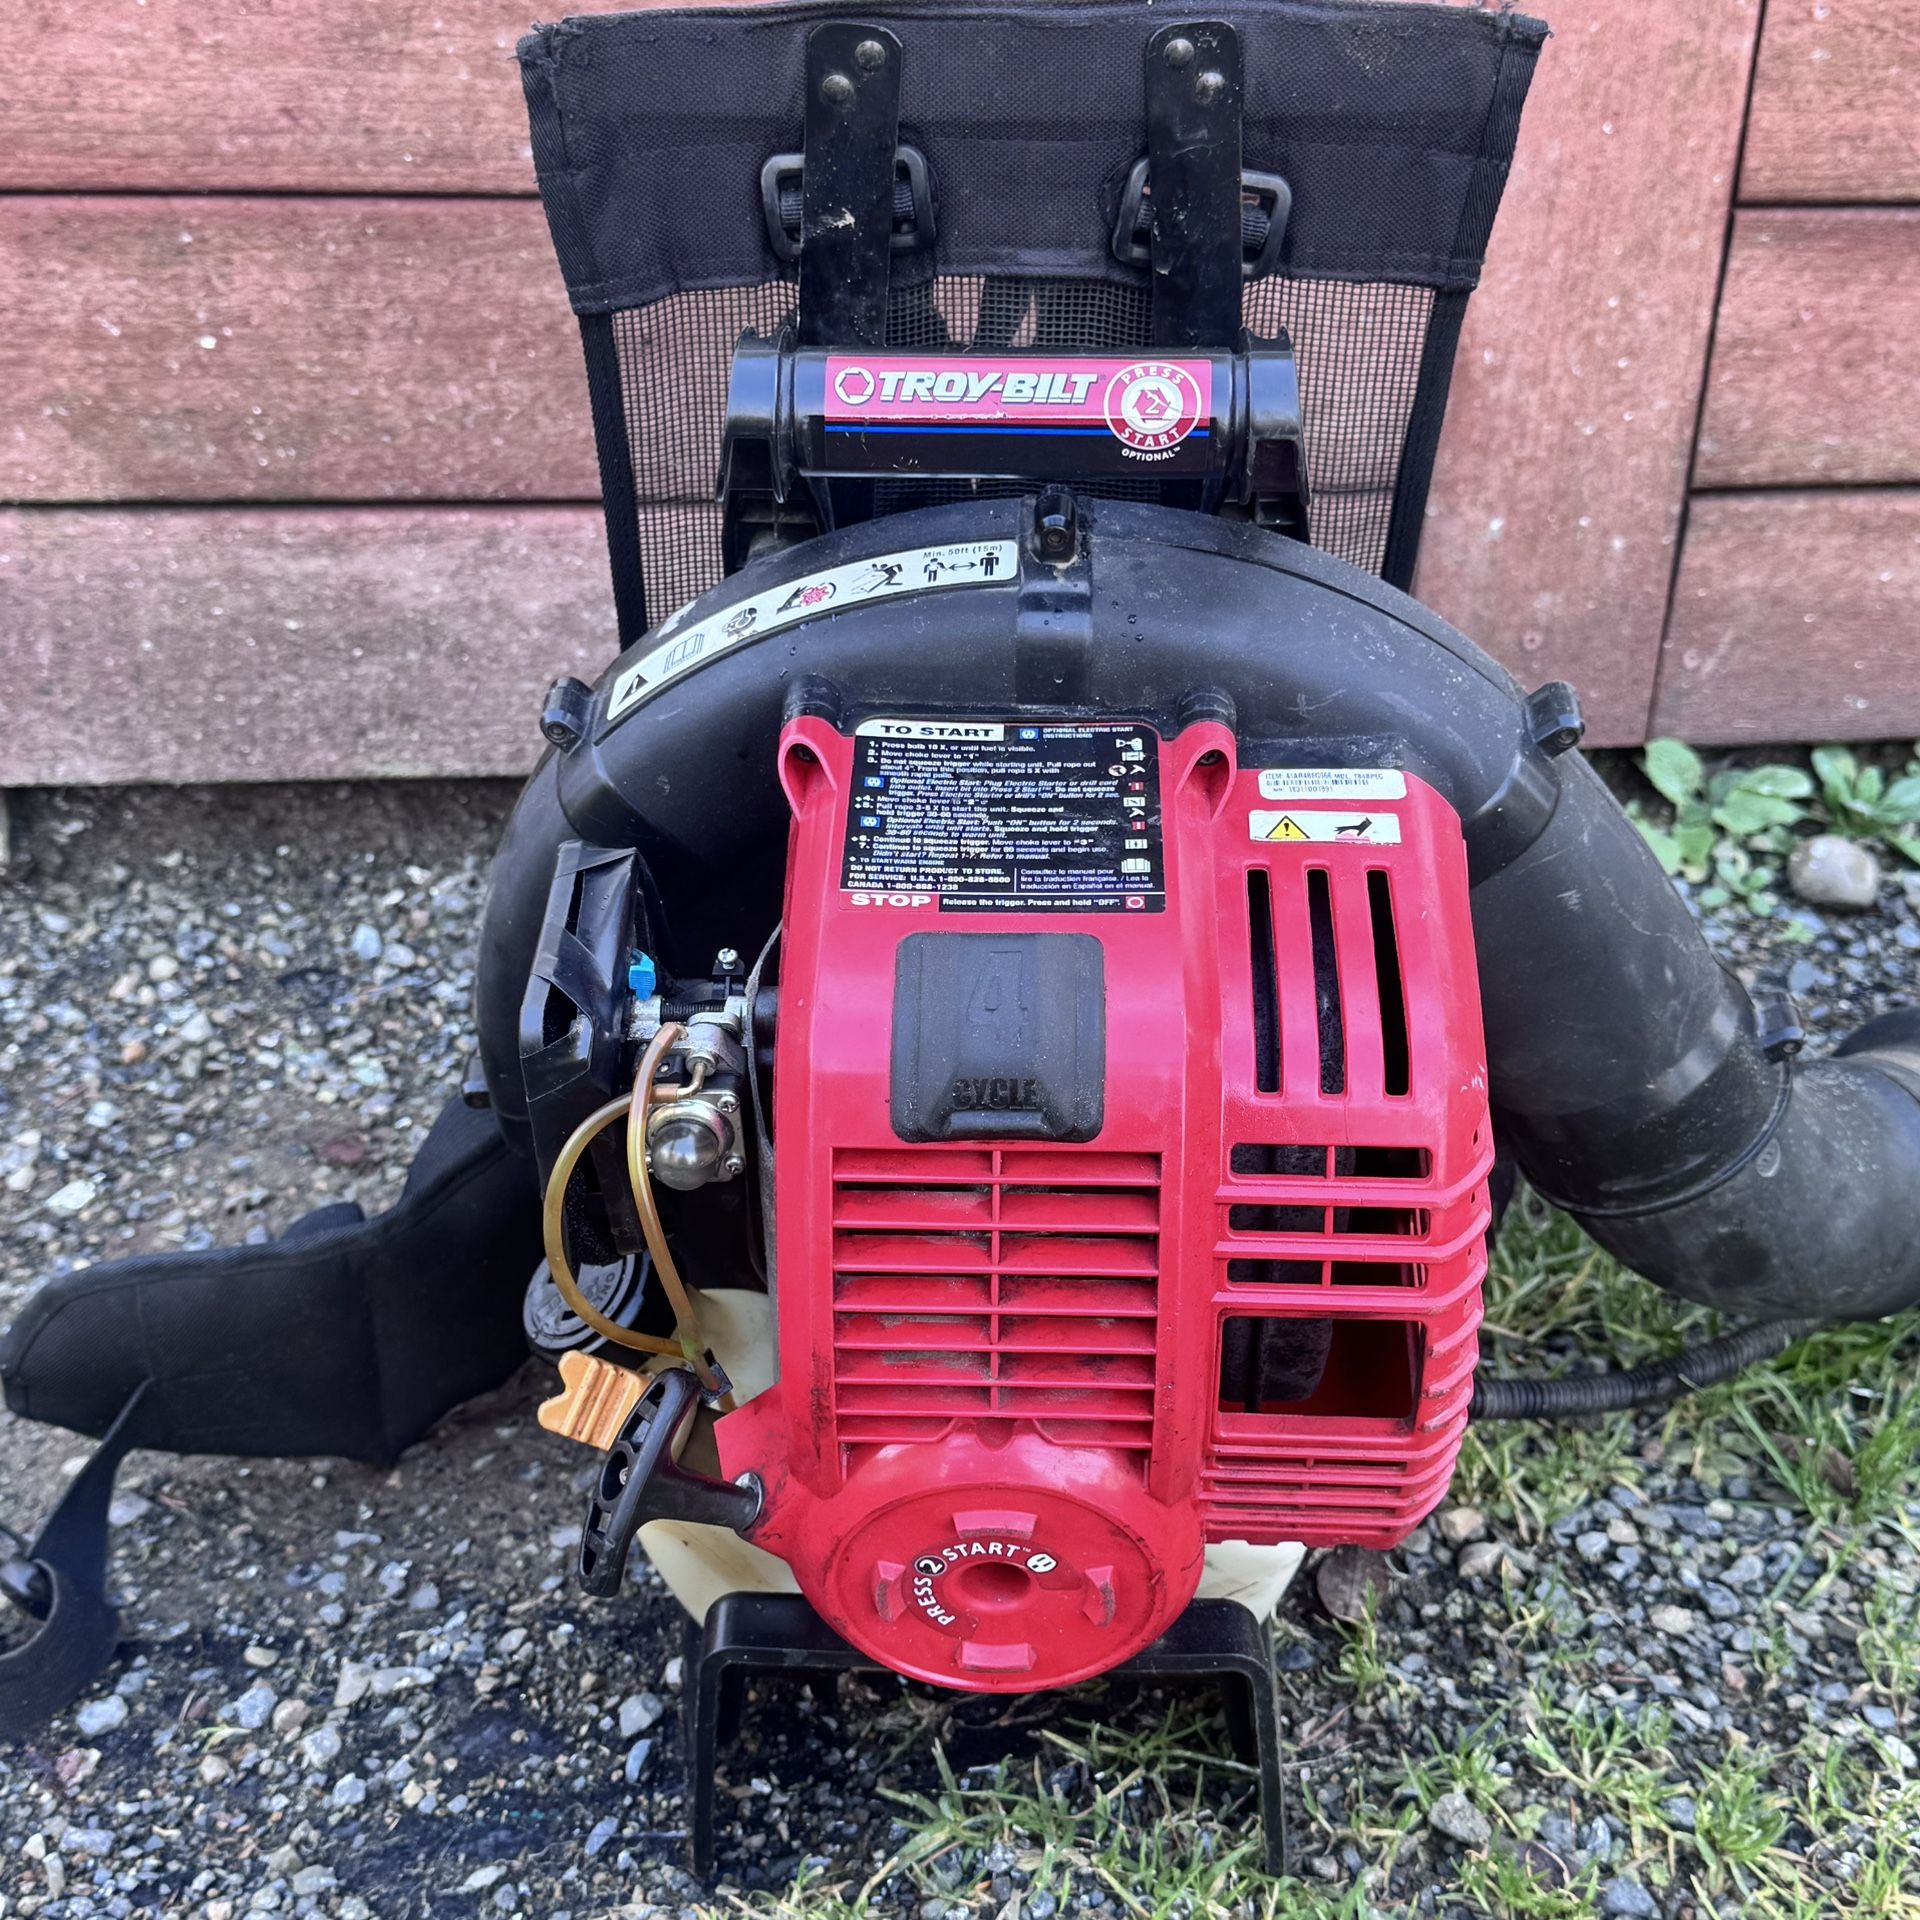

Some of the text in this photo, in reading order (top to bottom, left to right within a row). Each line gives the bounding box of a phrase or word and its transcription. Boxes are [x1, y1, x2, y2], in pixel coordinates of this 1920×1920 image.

[1120, 366, 1184, 385] PRESS
[878, 371, 1099, 405] TROY-BILT
[1145, 389, 1160, 414] 2
[1121, 427, 1181, 447] START
[923, 544, 1003, 559] Min. 50ft (15m)
[880, 725, 995, 737] TO START
[850, 892, 932, 907] STOP
[995, 899, 1026, 907] trigger.
[952, 1077, 1038, 1110] CYCLE
[919, 1558, 943, 1574] 2
[913, 1576, 956, 1626] PRESS
